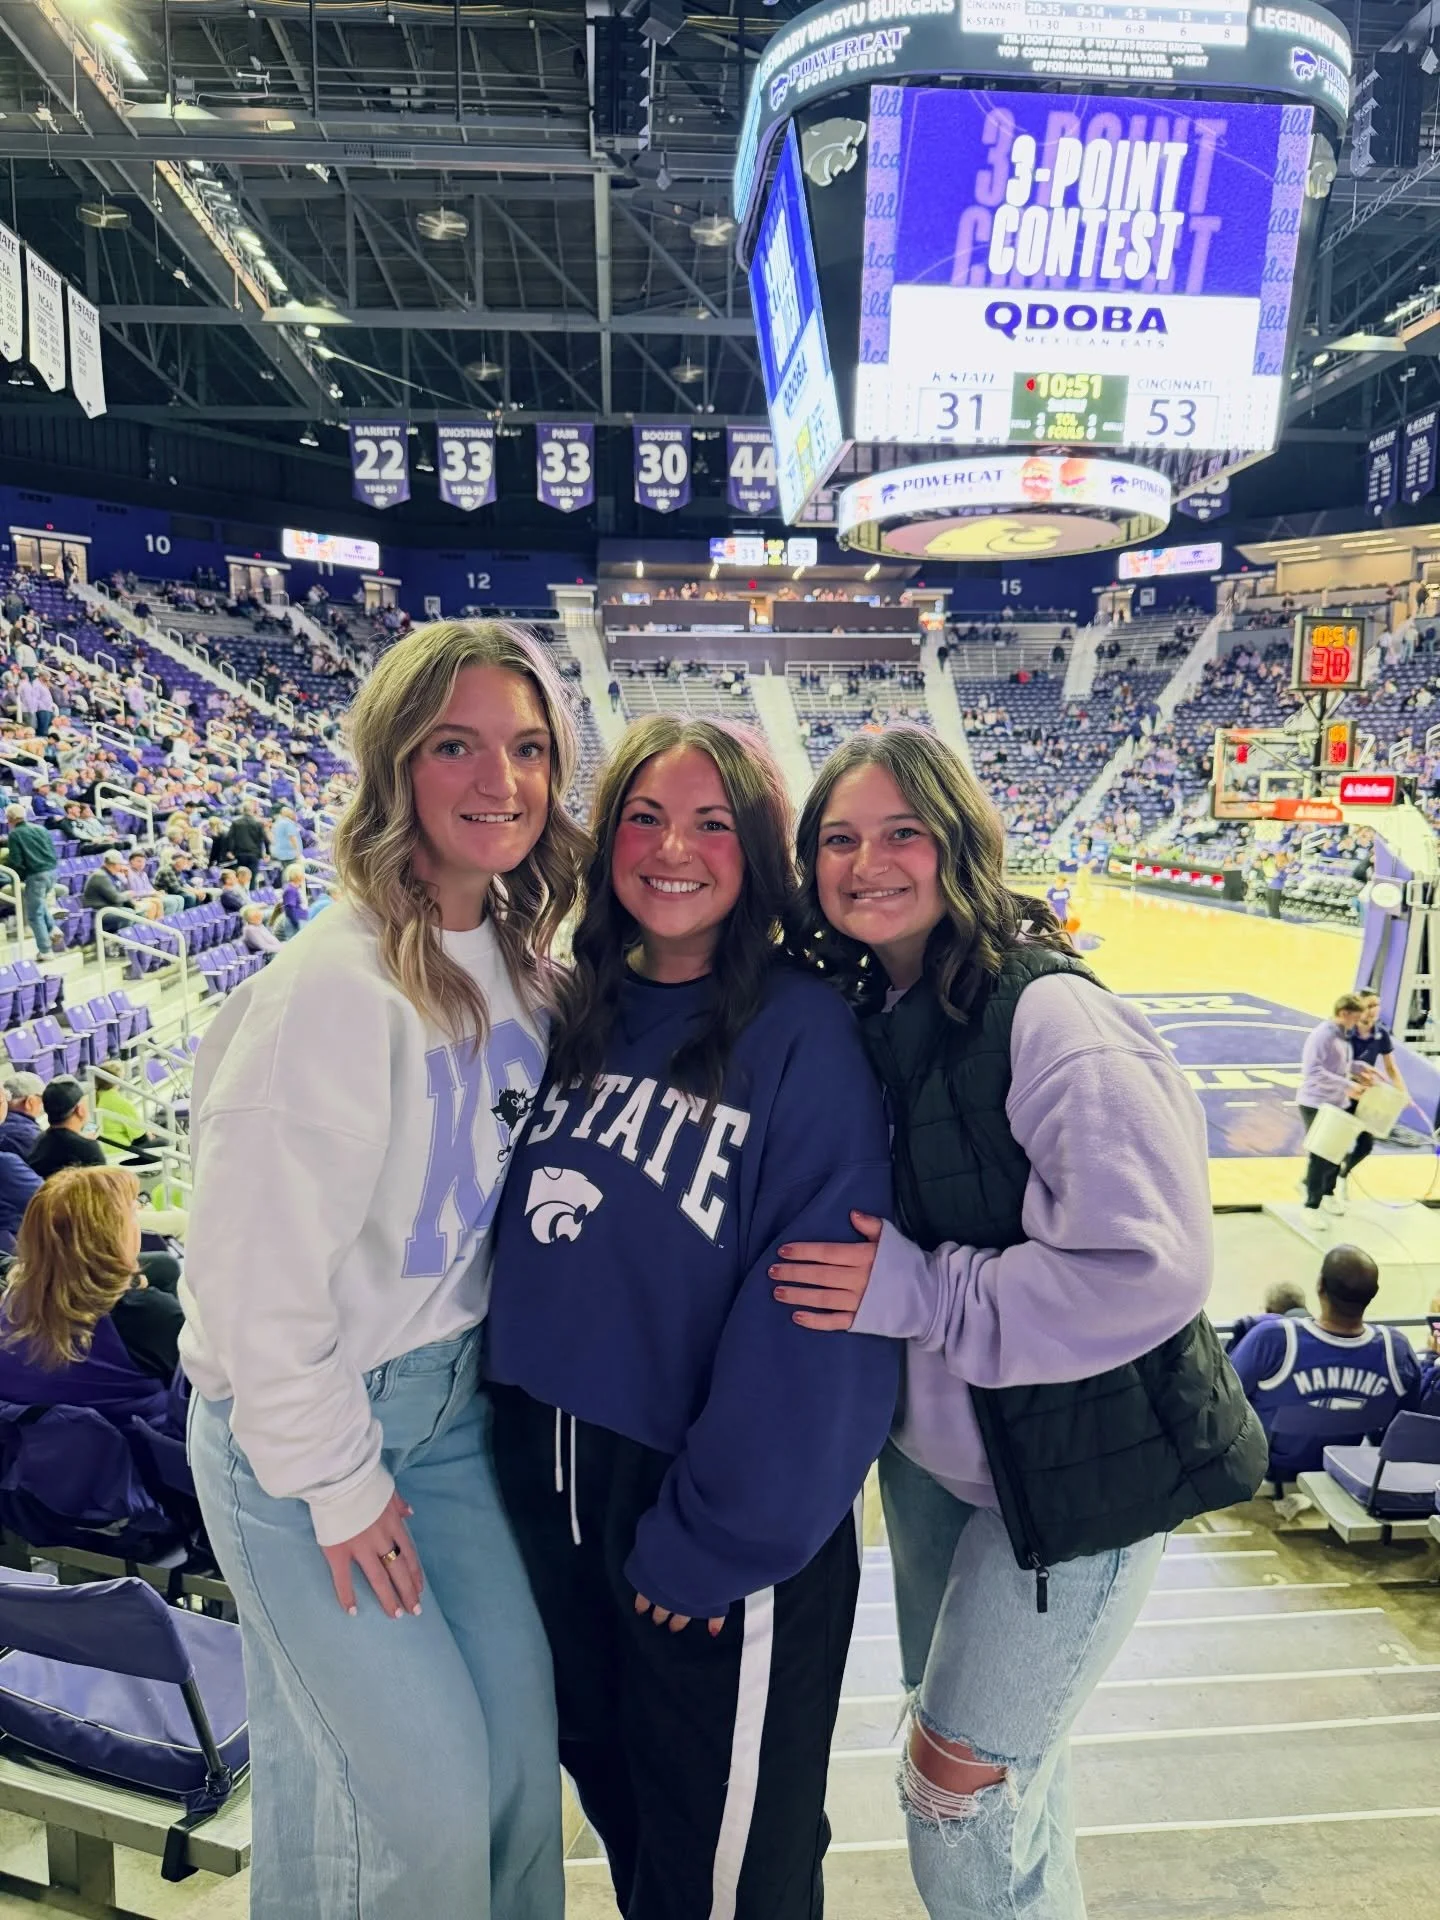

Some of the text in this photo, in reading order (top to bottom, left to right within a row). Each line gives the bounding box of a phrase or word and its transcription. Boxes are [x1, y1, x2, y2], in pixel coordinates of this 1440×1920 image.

[807, 3, 865, 43] WAGYU
[868, 0, 954, 22] BURGERS
[1179, 10, 1191, 22] 13
[789, 27, 910, 86] POWERCAT
[998, 45, 1018, 57] YOU
[1049, 48, 1070, 60] AND
[1095, 39, 1115, 50] YOU
[797, 50, 896, 92] SPORTS GRILL
[1005, 134, 1188, 212] 3-POINT
[988, 203, 1185, 280] CONTEST
[30, 258, 58, 292] K-STATE
[72, 295, 96, 325] K-STATE
[984, 301, 1169, 341] QDOBA
[1025, 336, 1165, 348] MEXICAN EATS
[1037, 373, 1102, 399] 10:51
[1137, 378, 1213, 392] CINCINNATI
[936, 392, 983, 431] 31
[1146, 399, 1198, 437] 53
[355, 425, 401, 437] BARRETT
[438, 427, 493, 439] KNOSTMAN
[641, 429, 683, 442] BOOZER
[732, 431, 773, 443] MURREL
[354, 439, 405, 480] 22
[442, 440, 492, 482] 33
[542, 442, 591, 484] 33
[638, 443, 688, 485] 30
[729, 445, 776, 486] 44
[903, 470, 1005, 491] POWERCAT
[145, 534, 171, 555] 10
[466, 572, 491, 590] 12
[1000, 579, 1022, 596] 15
[1312, 626, 1356, 647] 10:51
[1310, 647, 1351, 683] 30
[527, 1073, 750, 1246] STATE
[1293, 1367, 1389, 1397] MANNING
